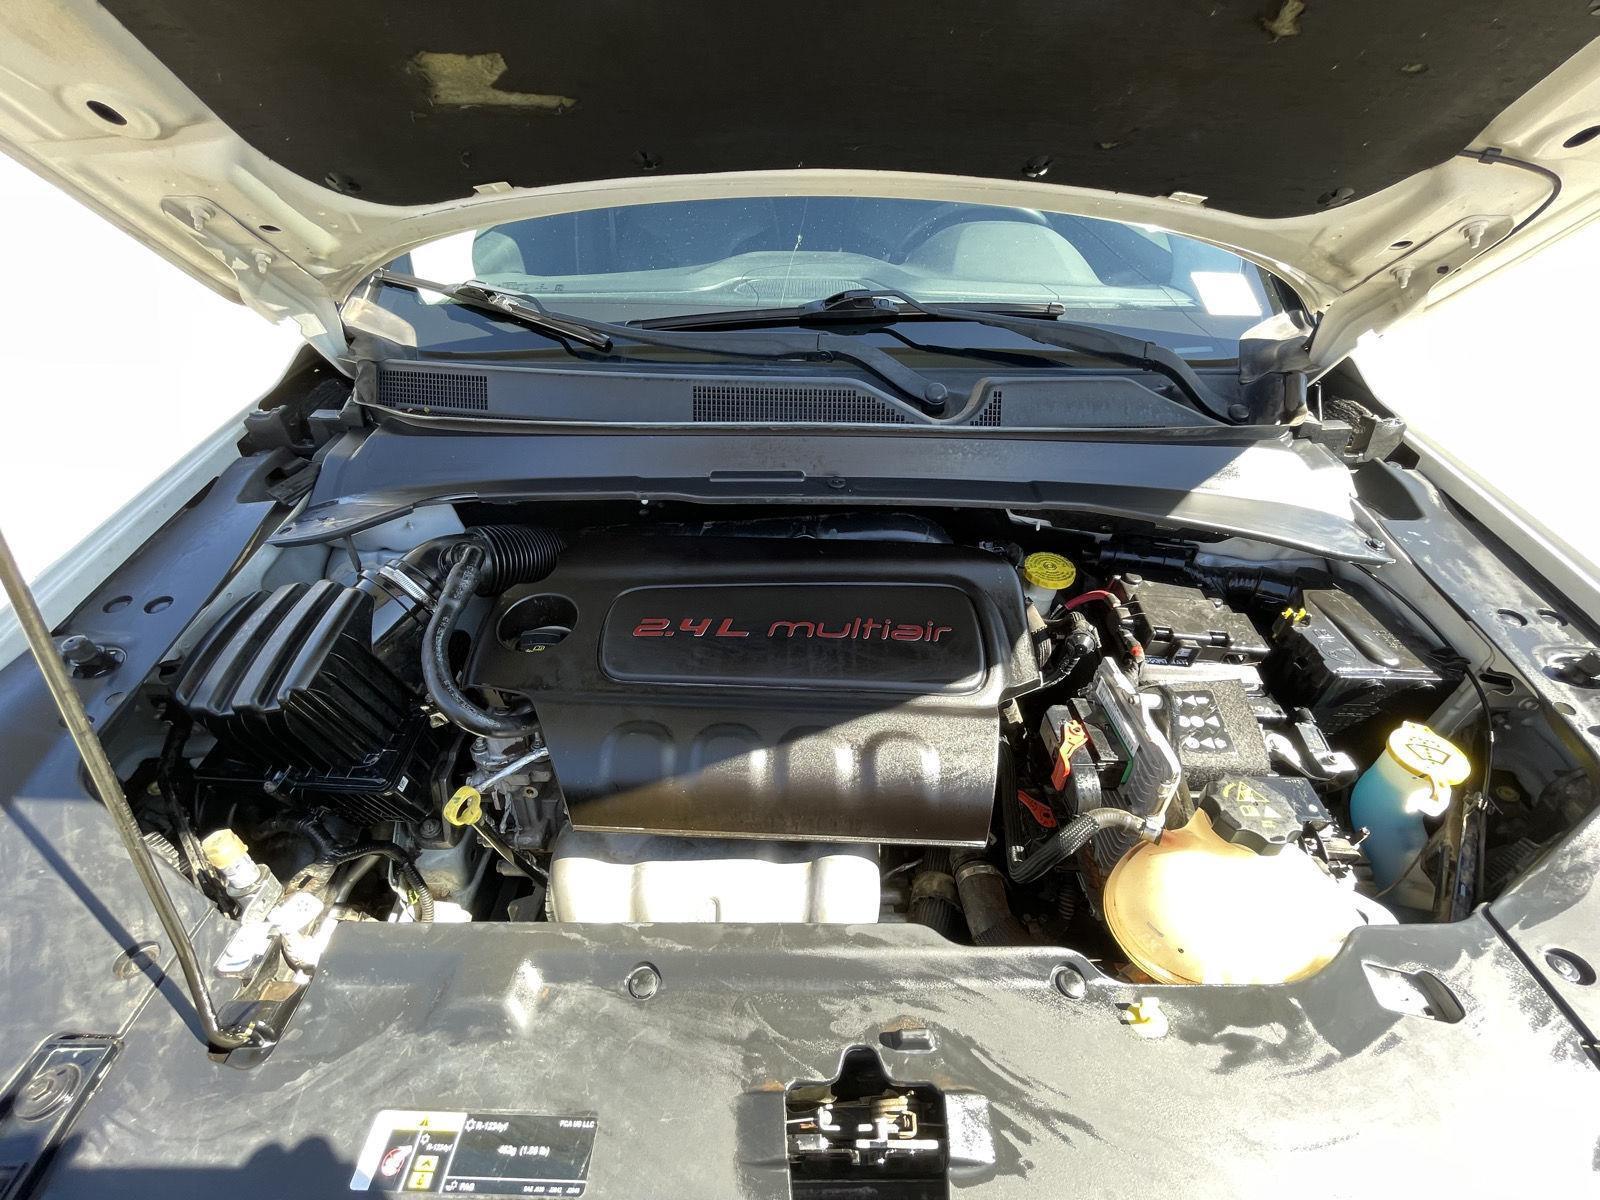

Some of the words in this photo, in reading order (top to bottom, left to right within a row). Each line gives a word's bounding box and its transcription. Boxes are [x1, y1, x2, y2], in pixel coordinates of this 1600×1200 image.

[632, 617, 749, 637] 2.4L
[767, 616, 953, 643] multiair
[582, 1120, 595, 1129] LLC
